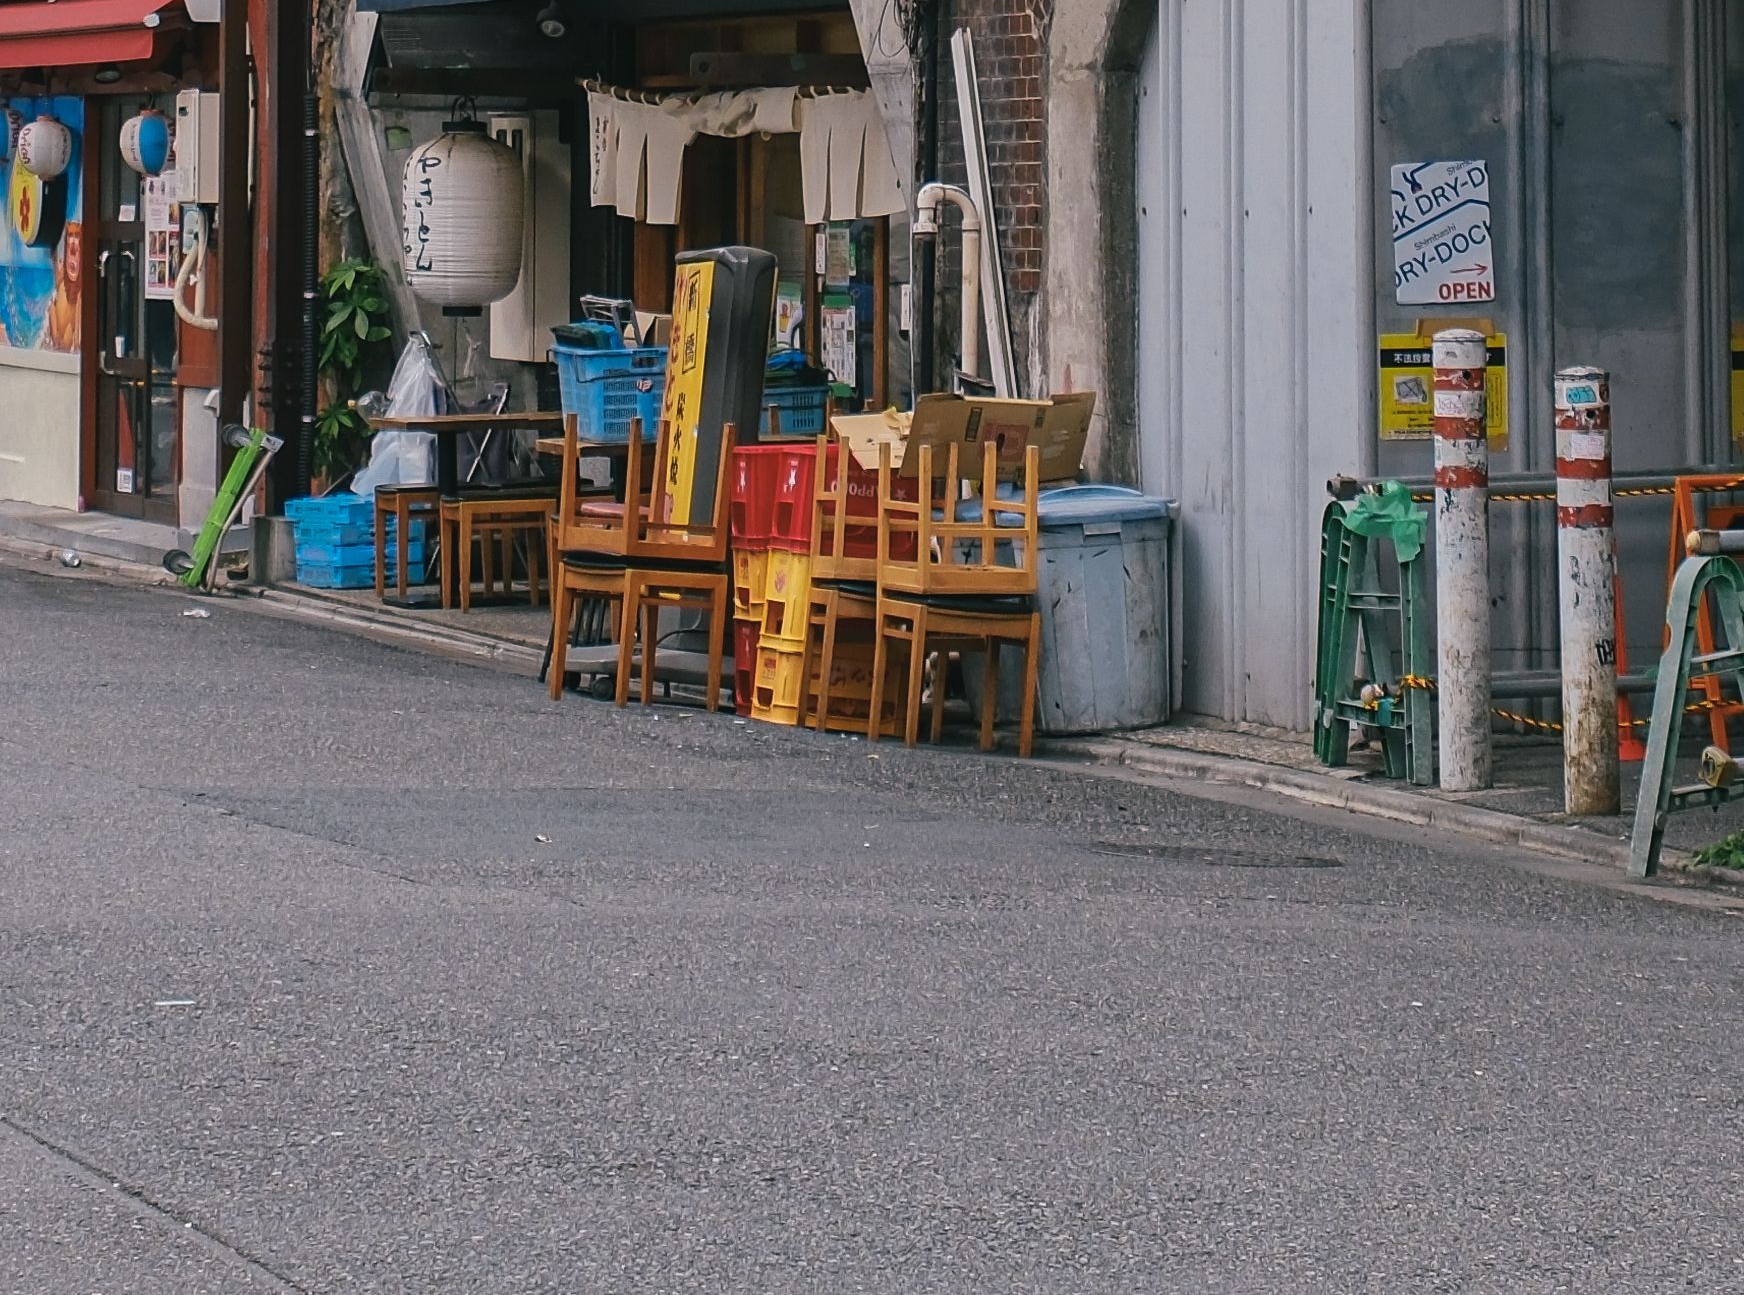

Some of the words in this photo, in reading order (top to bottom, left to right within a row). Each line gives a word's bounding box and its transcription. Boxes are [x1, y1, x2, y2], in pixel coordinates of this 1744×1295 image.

[415, 155, 443, 272] やきとん
[1414, 160, 1489, 216] DRY-D
[1438, 281, 1492, 301] OPEN
